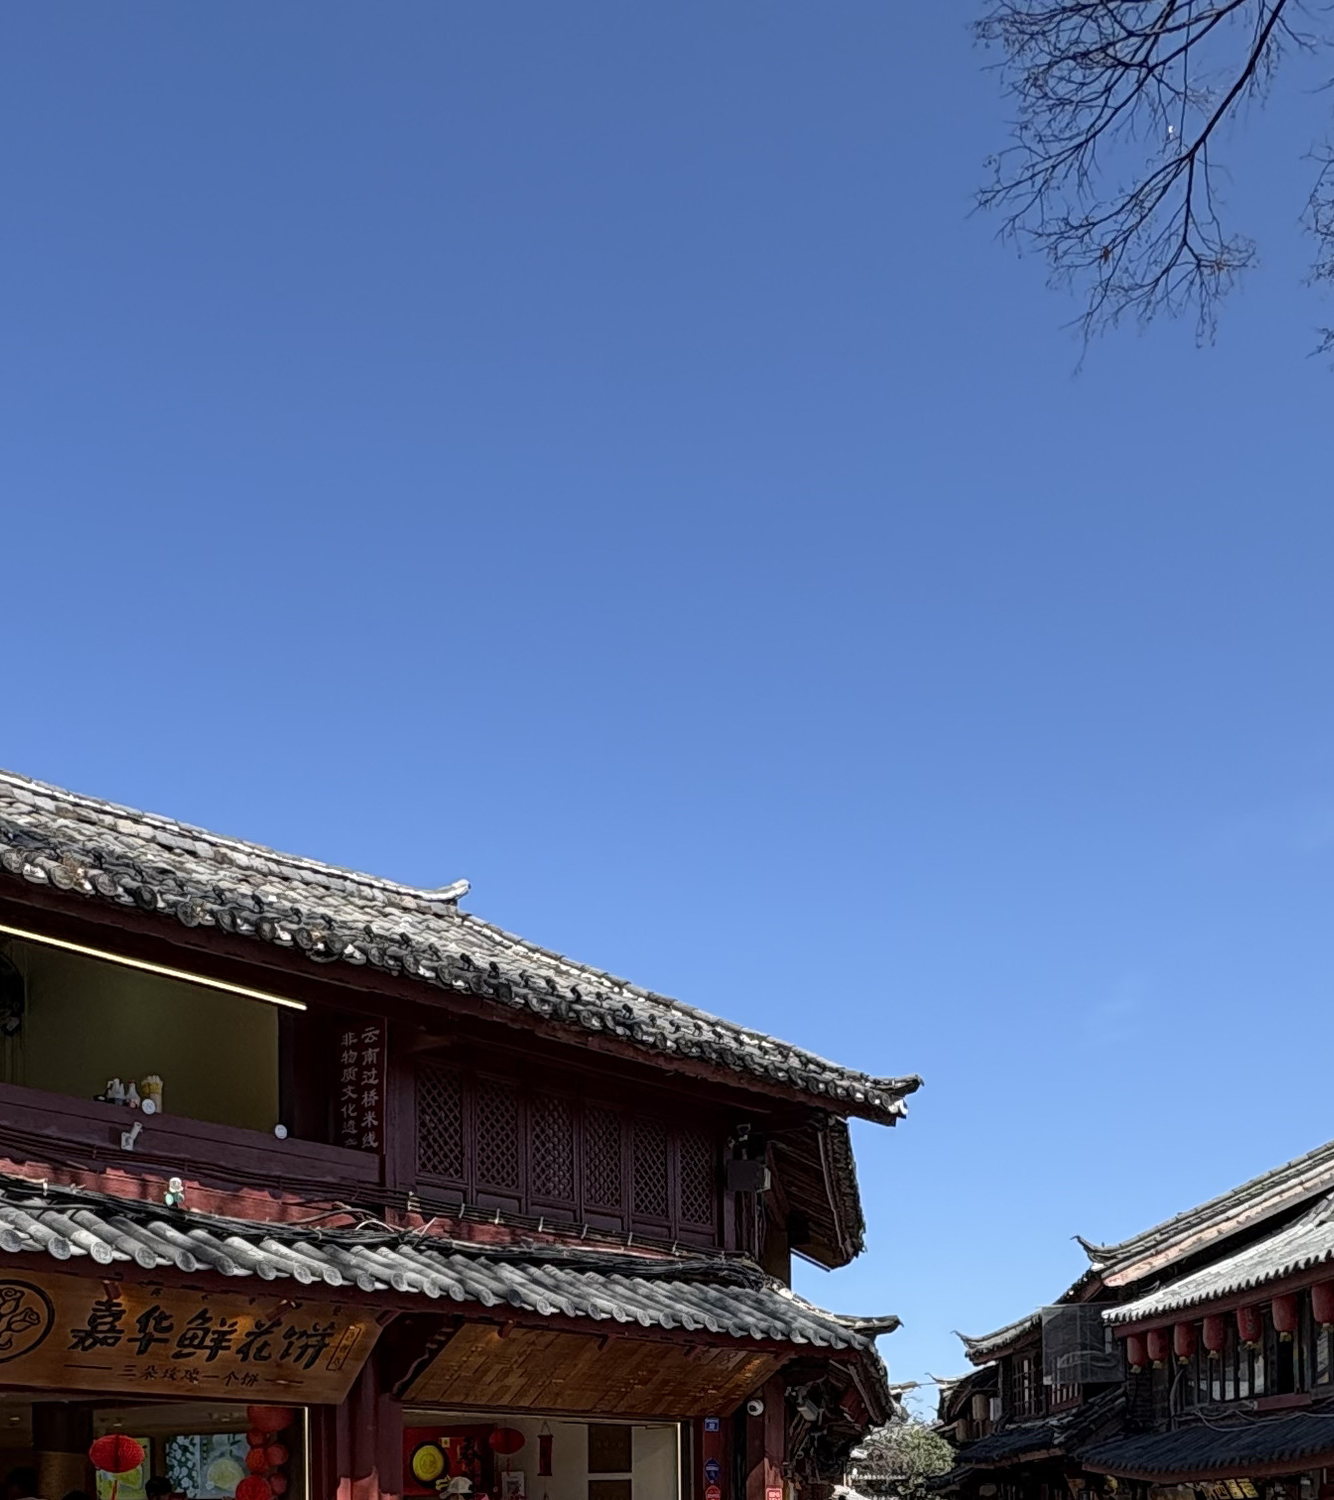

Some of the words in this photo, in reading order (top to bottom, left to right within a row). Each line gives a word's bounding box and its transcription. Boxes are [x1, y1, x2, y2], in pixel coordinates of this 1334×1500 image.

[361, 1026, 380, 1148] 云南过桥米线
[67, 1300, 336, 1370] 嘉华鲜花饼
